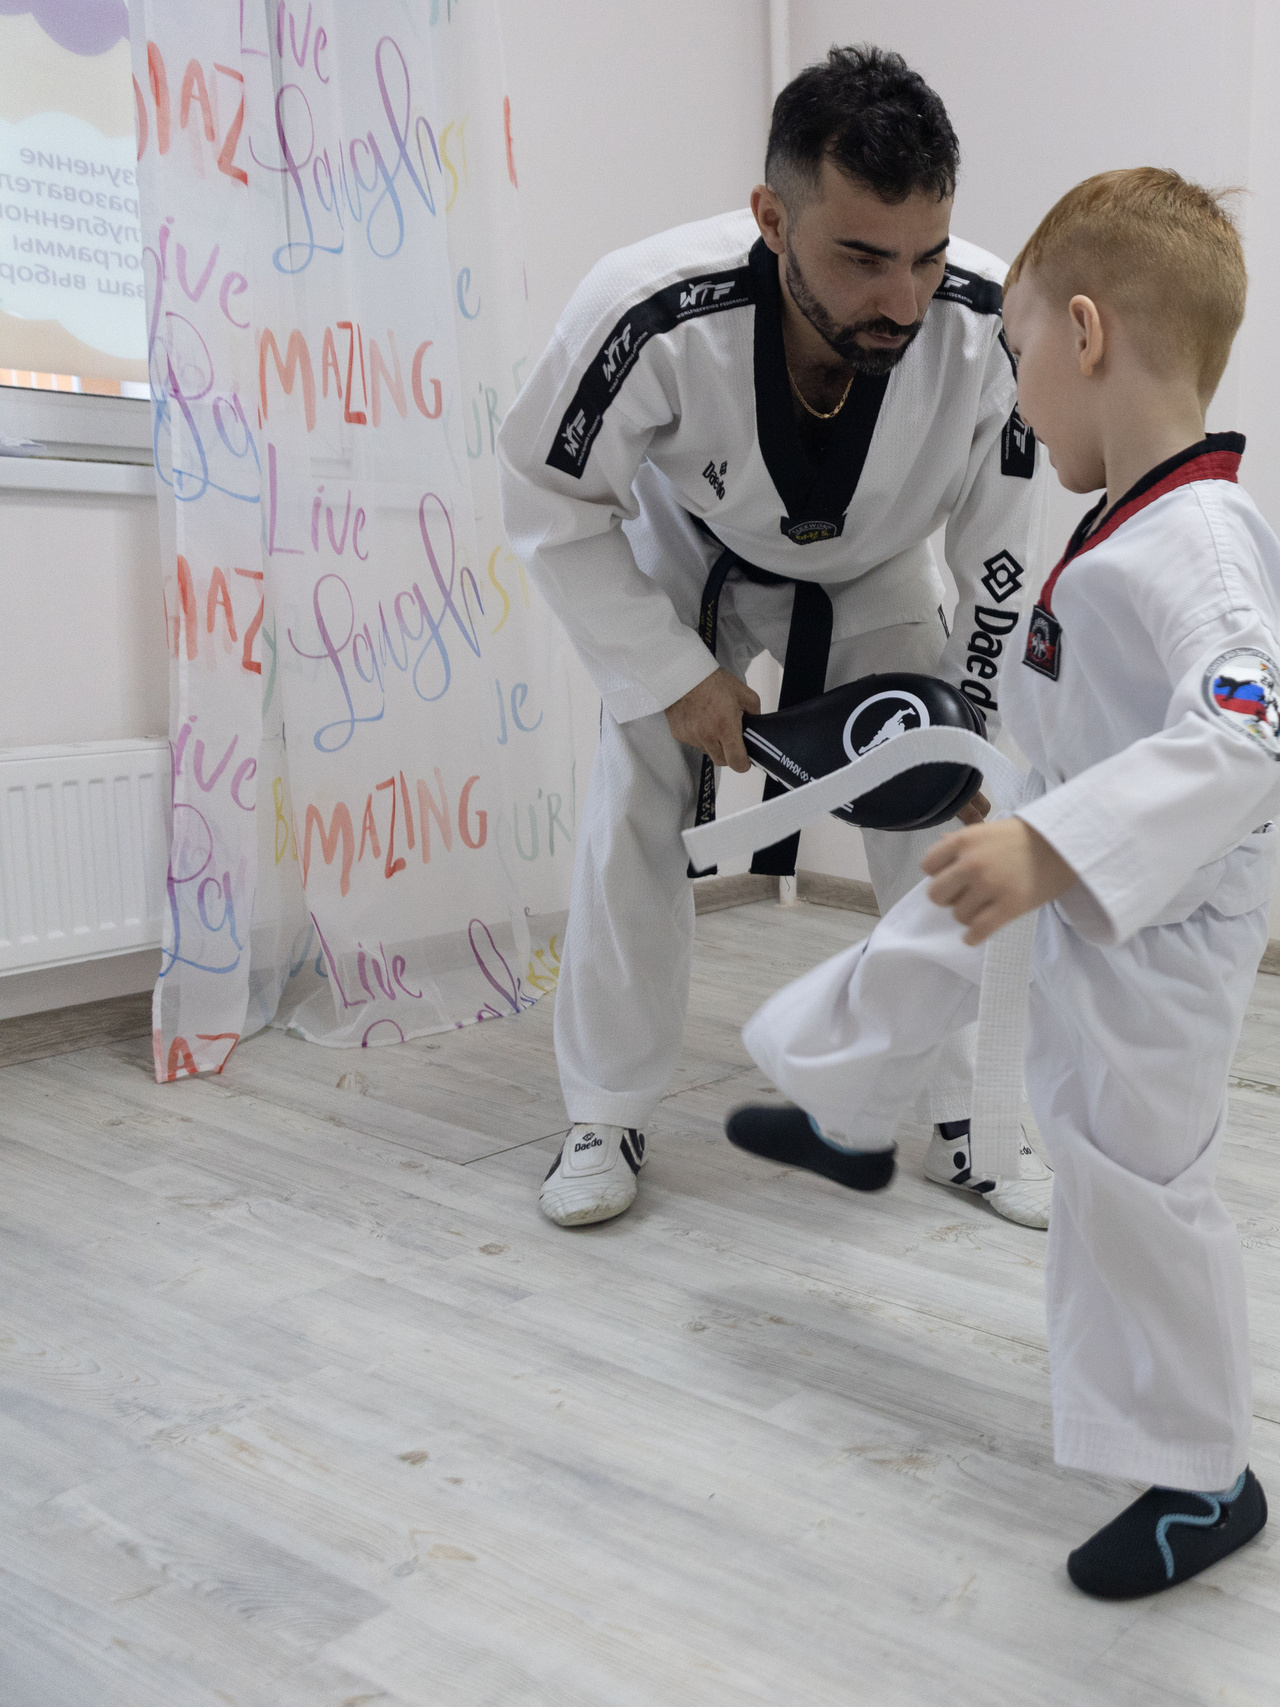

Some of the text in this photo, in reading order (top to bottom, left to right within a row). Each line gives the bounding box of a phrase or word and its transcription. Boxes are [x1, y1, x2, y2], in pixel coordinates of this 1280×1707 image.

[680, 280, 735, 309] WTF
[257, 320, 443, 433] MAZING
[602, 322, 632, 383] WTF
[561, 408, 587, 459] WTF
[267, 442, 369, 561] Live
[960, 604, 1019, 722] Daed
[780, 754, 802, 776] KHAN
[301, 766, 488, 898] MAZING
[310, 911, 423, 1010] Live
[574, 1137, 603, 1153] Daedo
